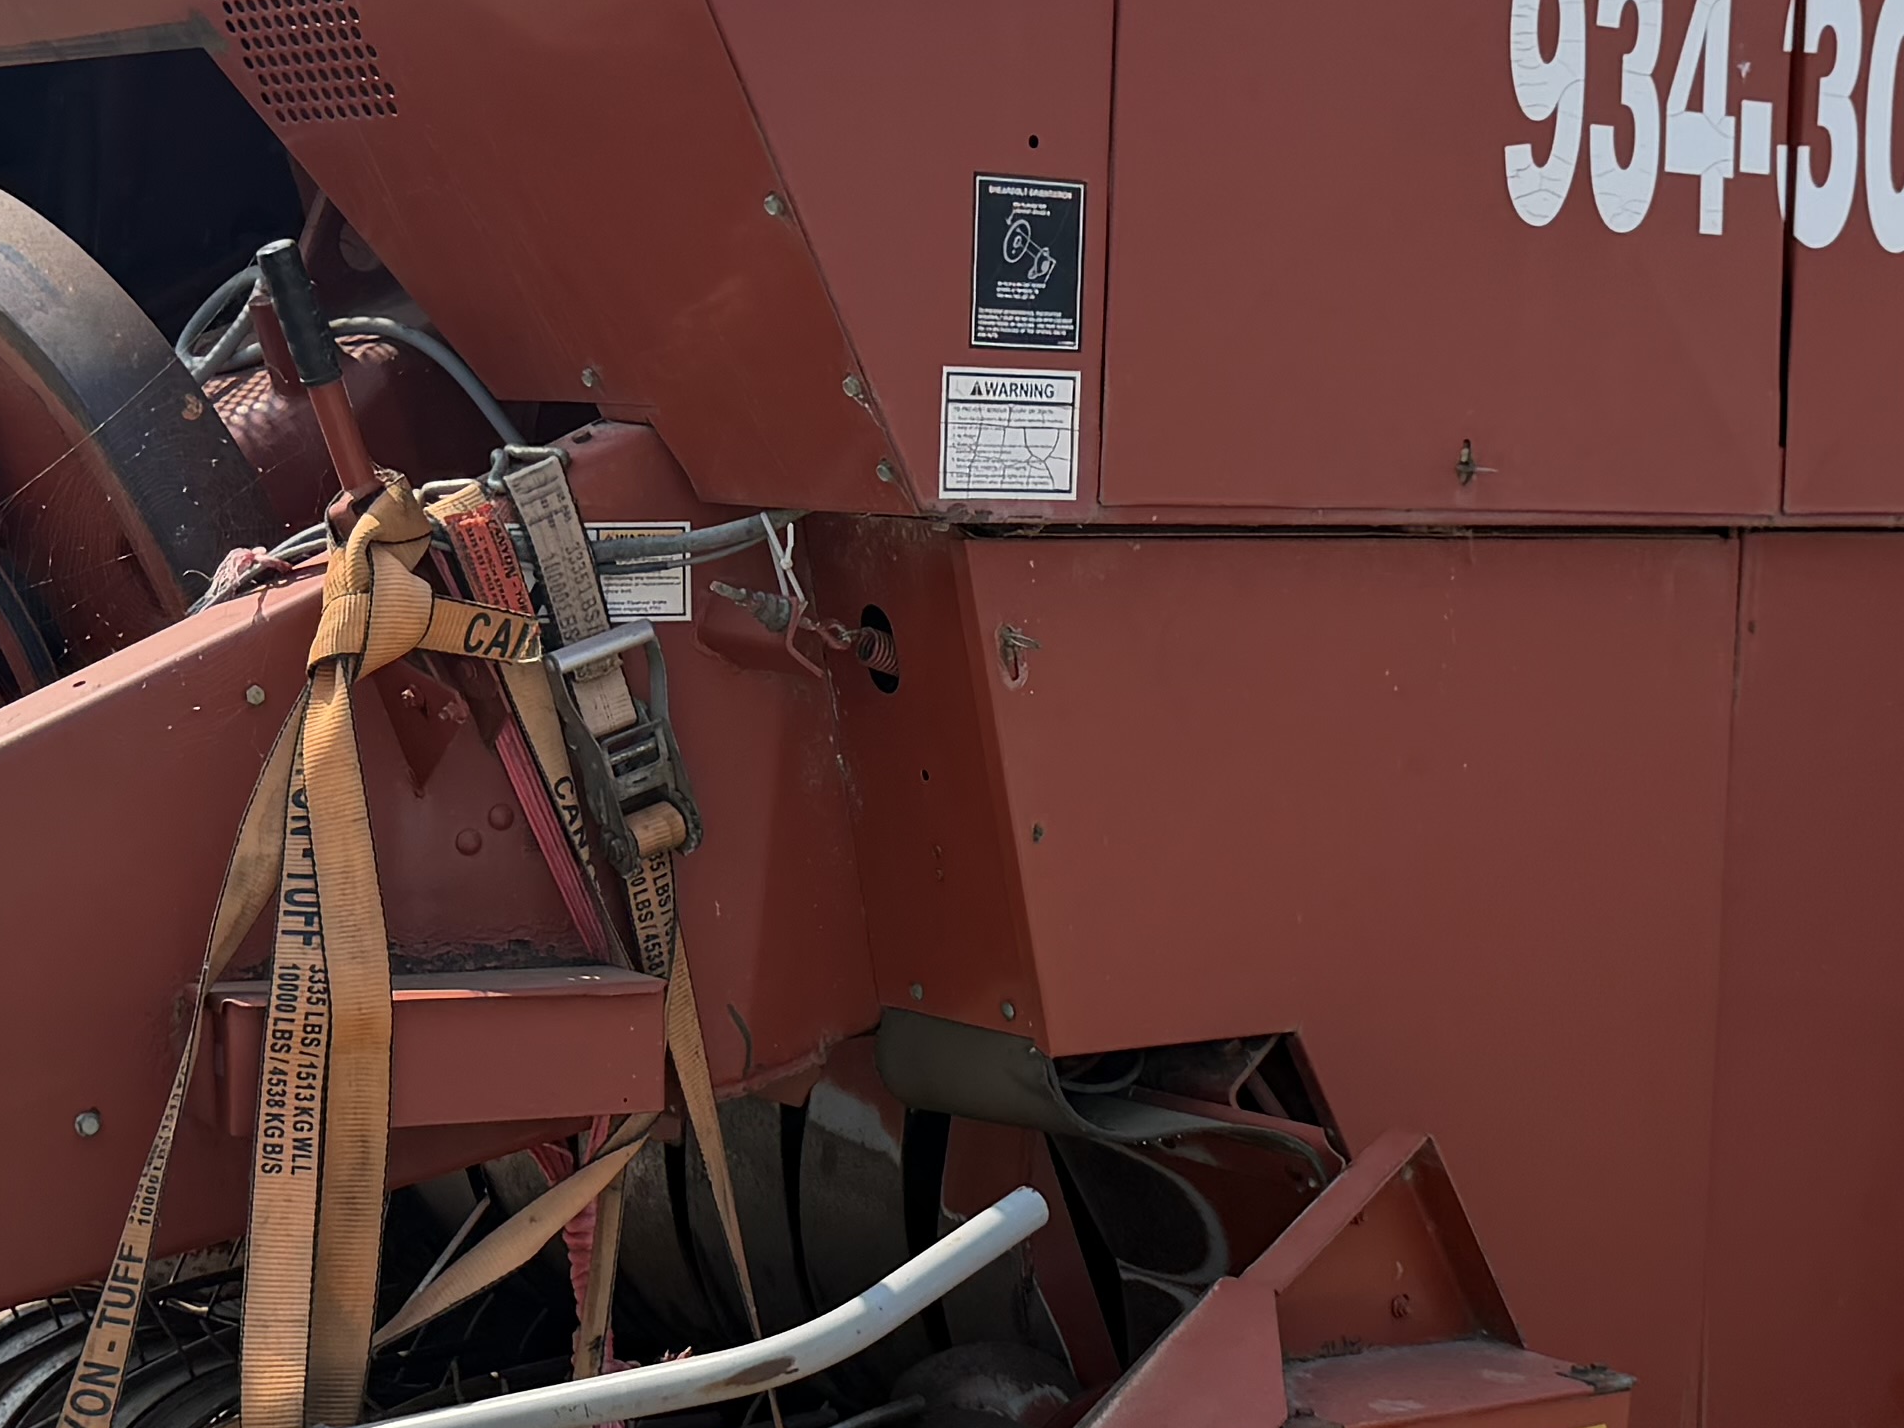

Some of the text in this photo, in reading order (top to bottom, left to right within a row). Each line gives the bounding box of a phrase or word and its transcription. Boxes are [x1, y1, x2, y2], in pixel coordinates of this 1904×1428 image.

[983, 380, 1056, 400] WARNING
[274, 963, 302, 1014] 10000
[305, 963, 330, 1007] 3335
[269, 1016, 296, 1055] LBS
[299, 1012, 325, 1048] LBS
[265, 1066, 289, 1109] 4538
[294, 1060, 319, 1103] 1513
[262, 1112, 286, 1139] KG
[292, 1105, 315, 1134] KG
[260, 1143, 285, 1176] B/S
[290, 1137, 313, 1176] WLL
[95, 1241, 145, 1329] TUFF
